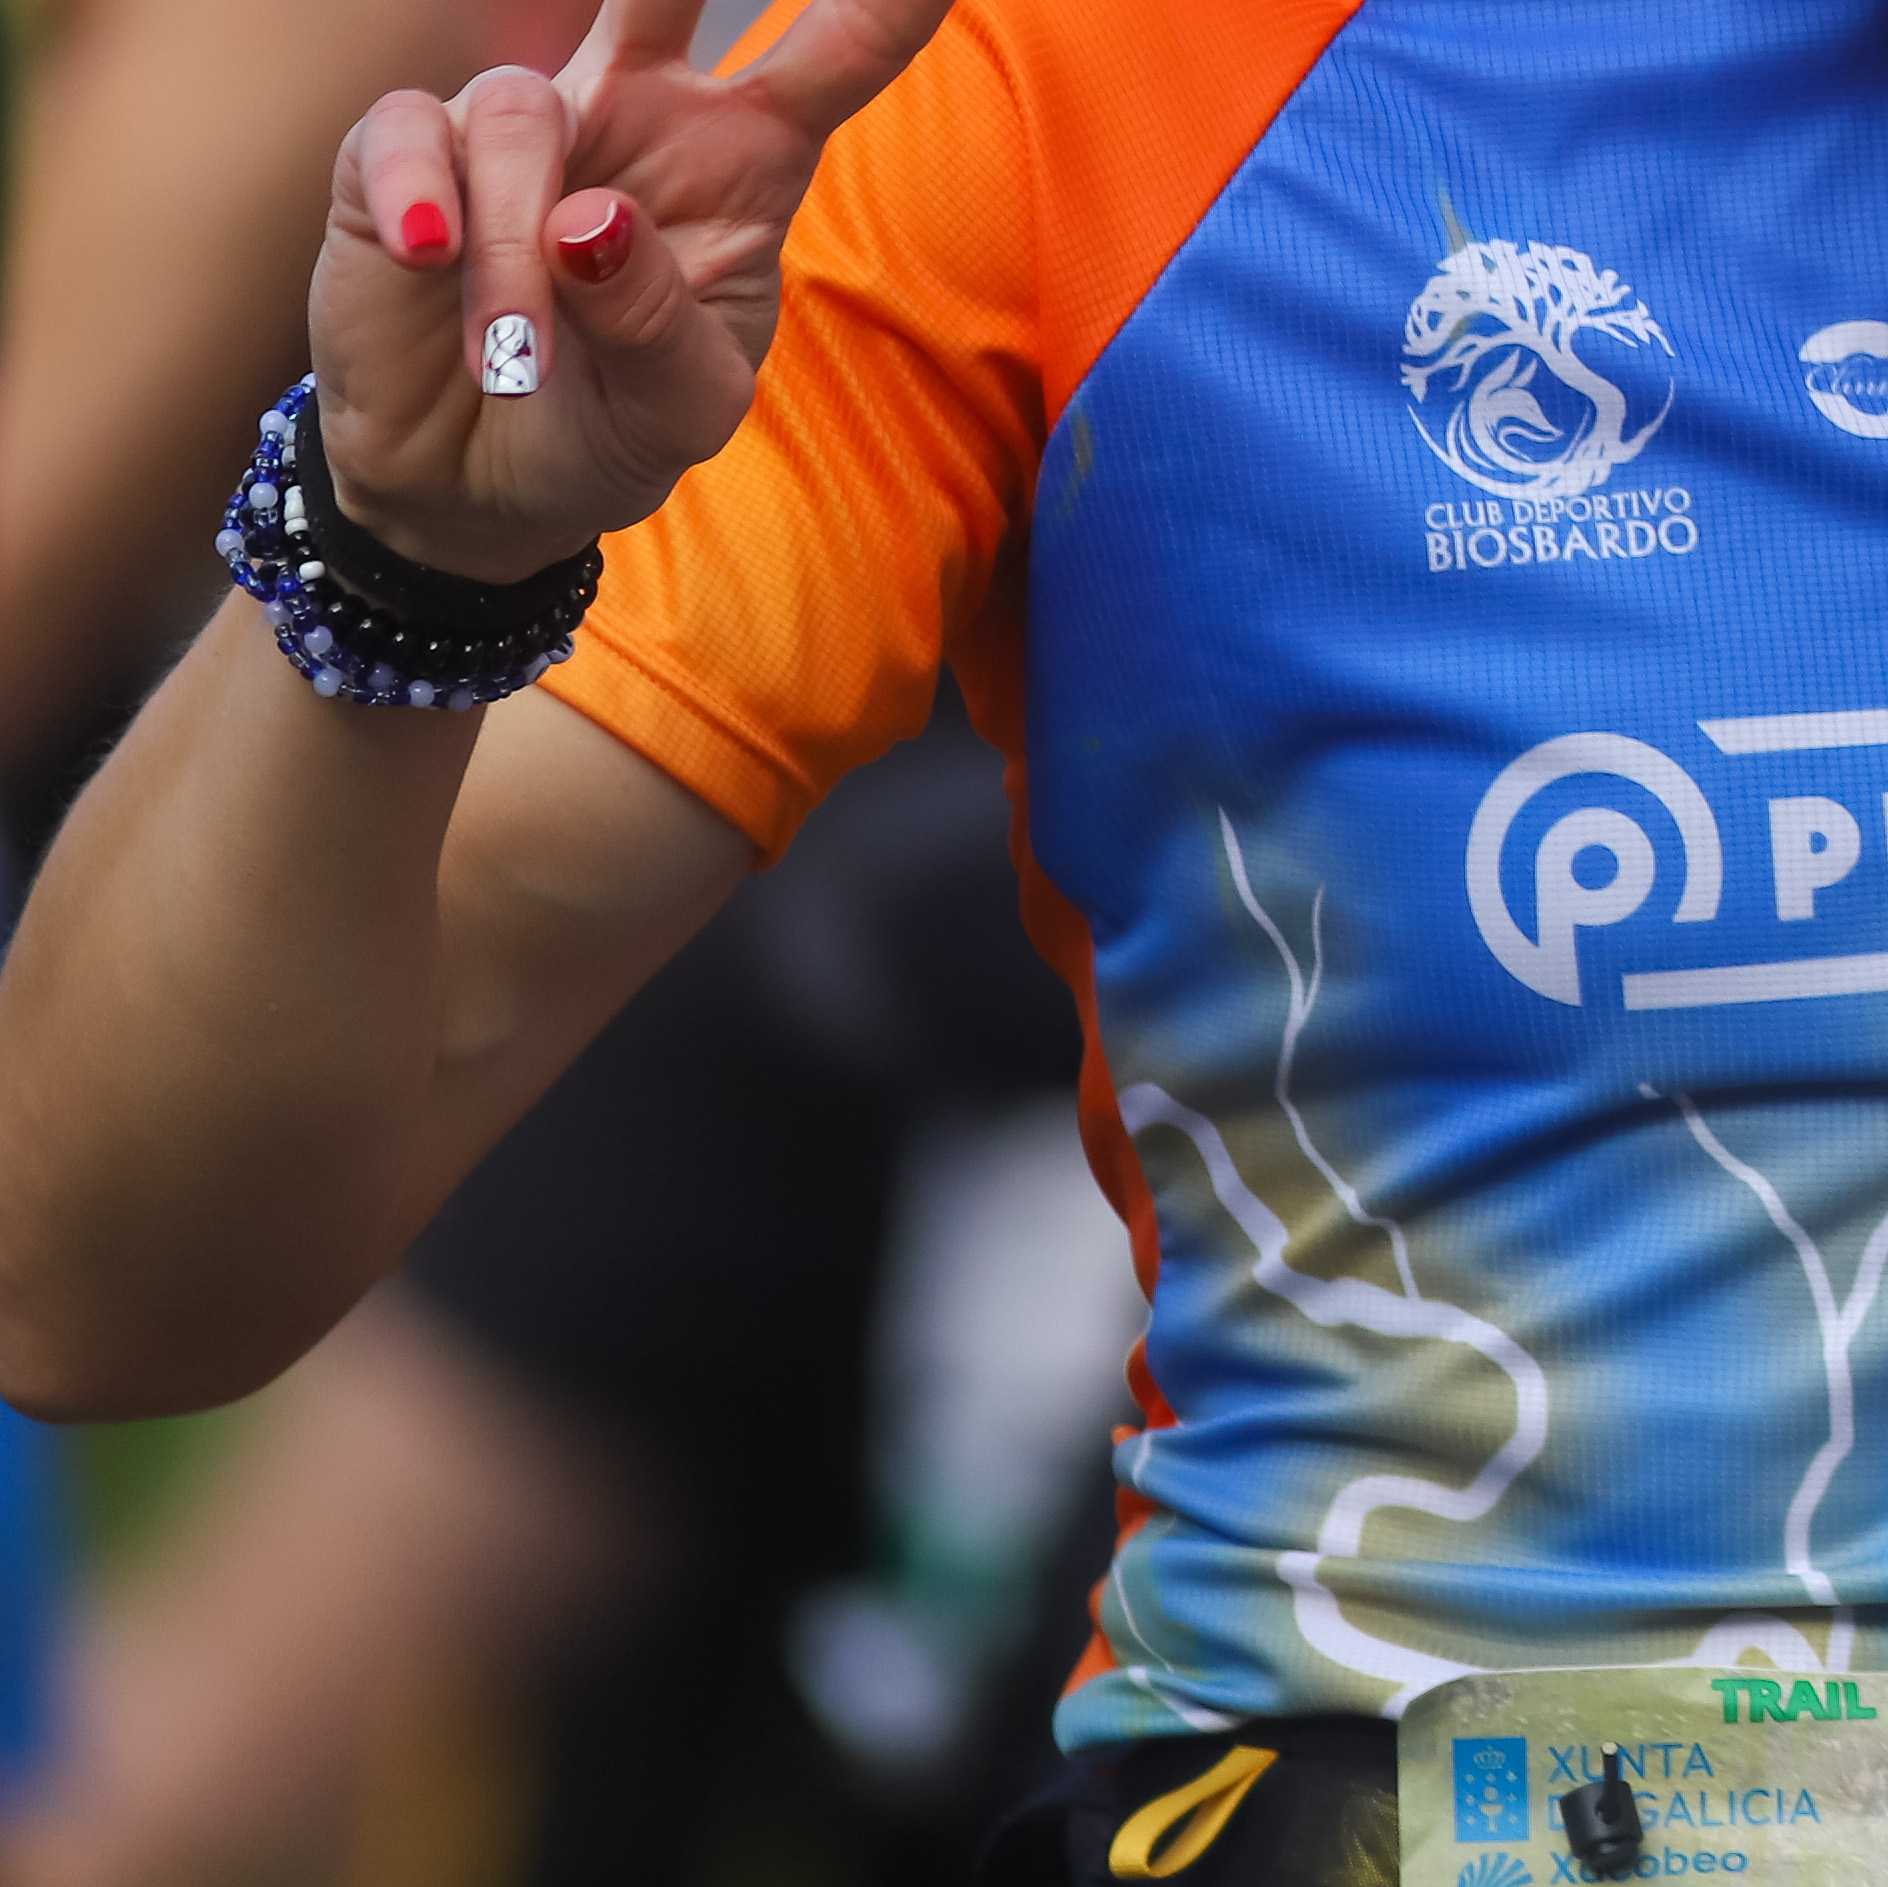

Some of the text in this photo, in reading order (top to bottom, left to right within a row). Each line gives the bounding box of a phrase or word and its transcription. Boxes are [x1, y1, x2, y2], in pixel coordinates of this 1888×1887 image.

[1424, 486, 1692, 531] CLUB DEPORTIVO
[1425, 514, 1698, 572] BIOSBARDO
[1711, 1677, 1878, 1724] TRAIL
